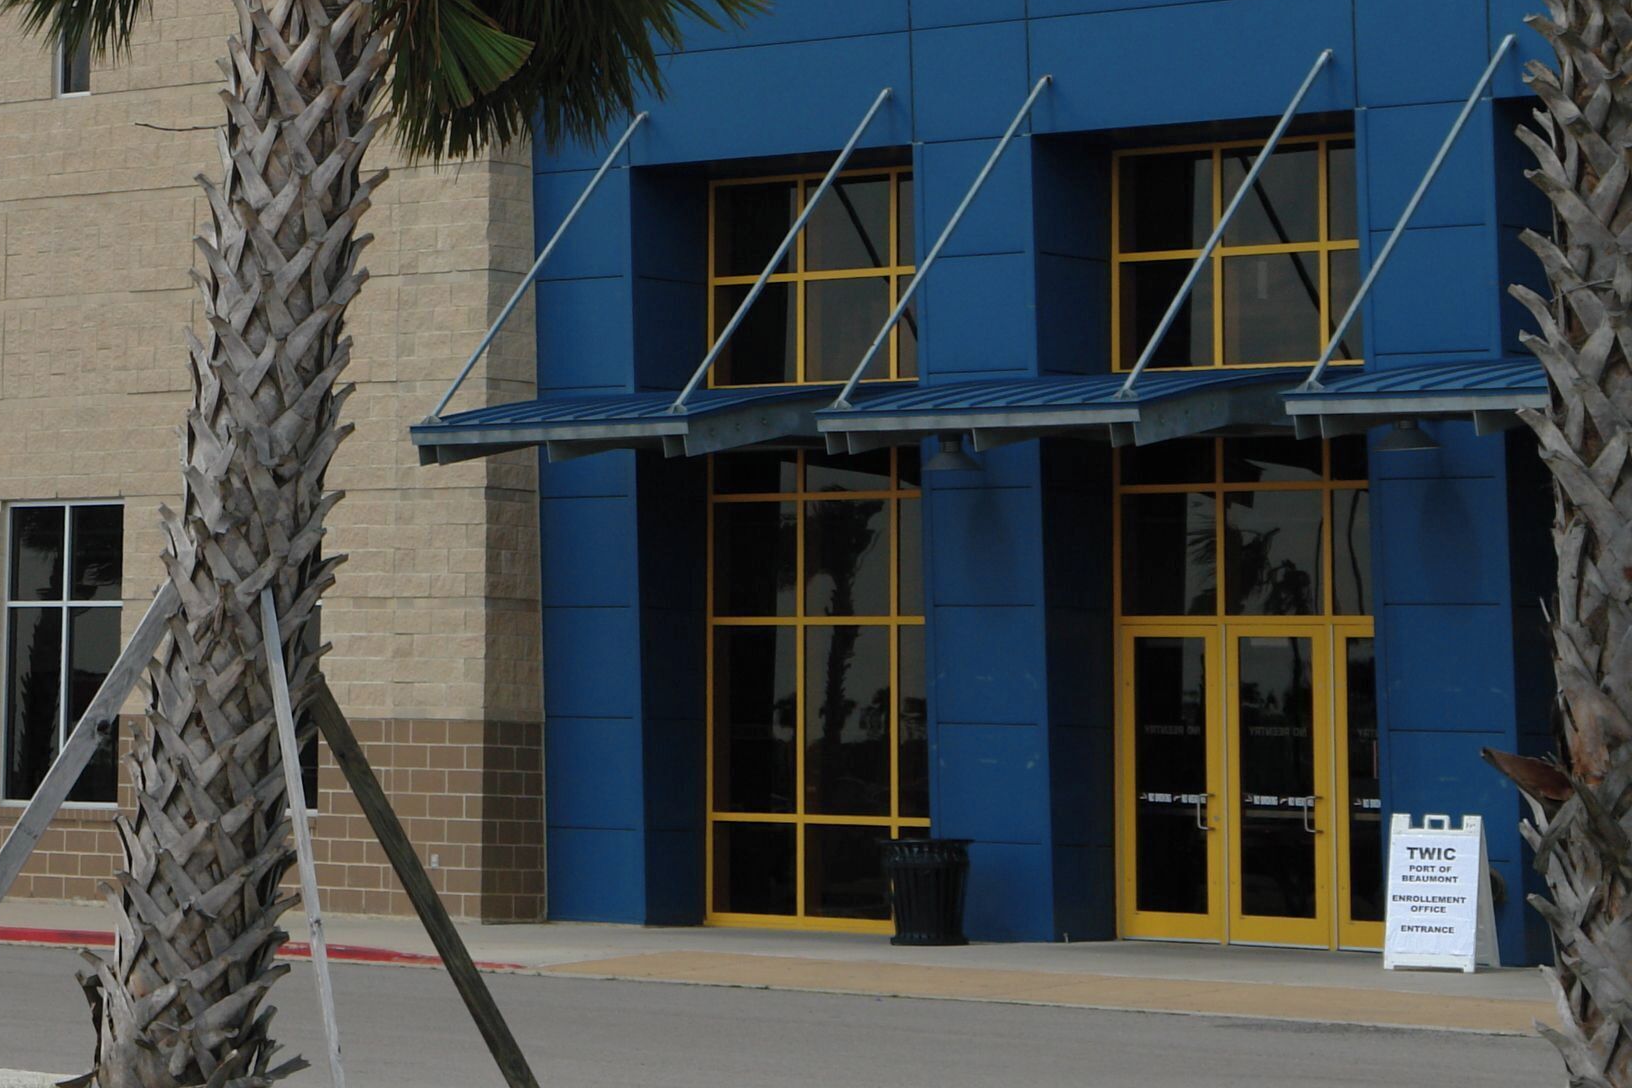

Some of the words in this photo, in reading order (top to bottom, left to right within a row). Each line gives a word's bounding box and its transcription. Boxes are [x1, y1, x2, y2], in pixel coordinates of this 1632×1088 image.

[1406, 846, 1456, 861] TWIC
[1409, 865, 1435, 873] PORT
[1438, 865, 1453, 873] OF
[1401, 875, 1459, 884] BEAUMONT
[1392, 894, 1467, 904] ENROLLEMENT
[1410, 905, 1447, 913] OFFICE
[1400, 924, 1455, 934] ENTRANCE
